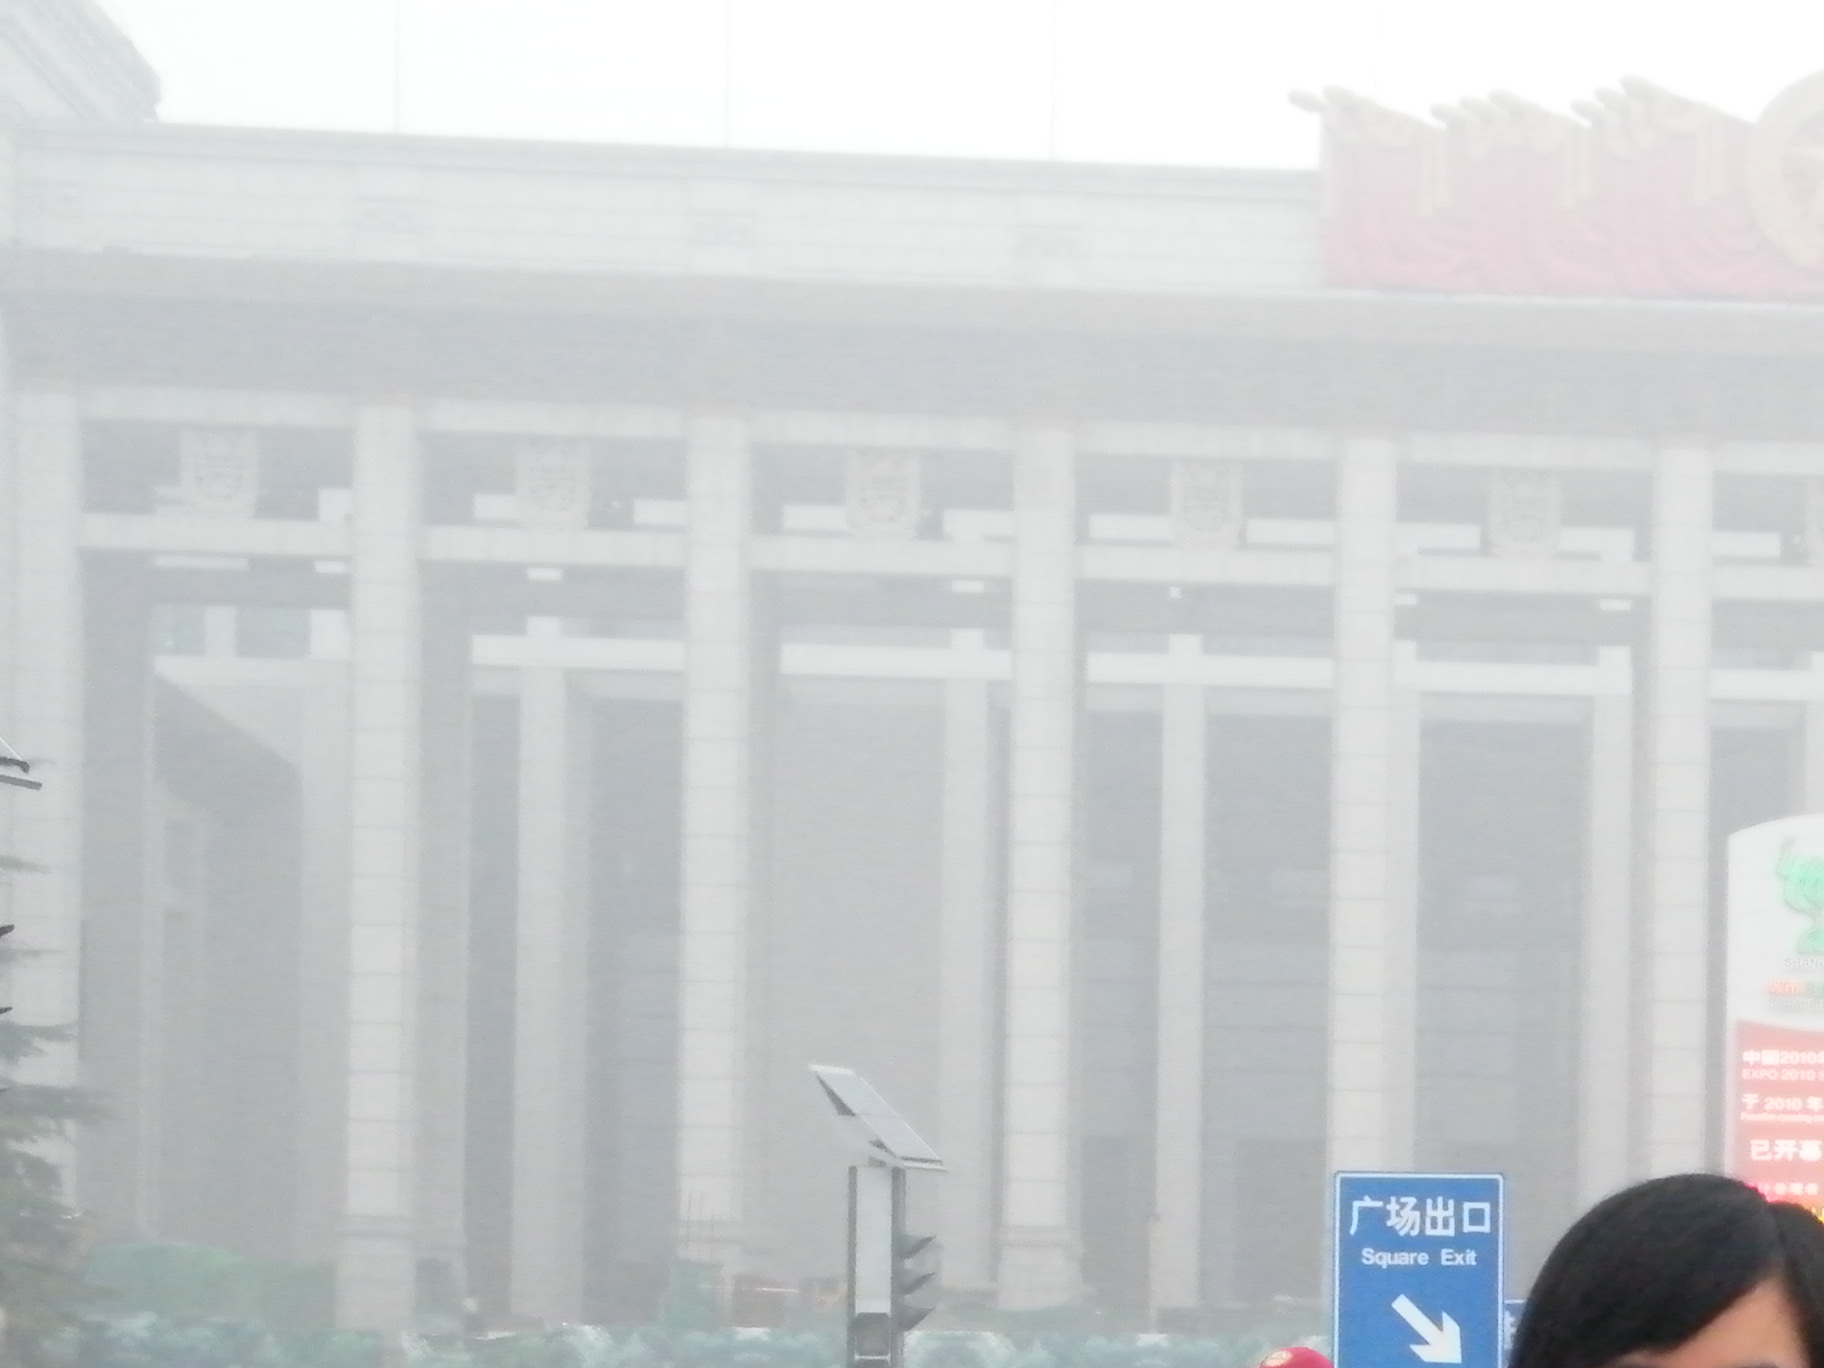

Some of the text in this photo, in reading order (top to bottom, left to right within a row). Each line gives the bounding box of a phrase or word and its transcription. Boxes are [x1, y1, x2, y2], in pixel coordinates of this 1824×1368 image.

[1742, 1069, 1778, 1081] EXPO
[1780, 1069, 1816, 1082] 2010
[1350, 1195, 1491, 1237] 广场出口
[1361, 1248, 1477, 1269] Square Exit
